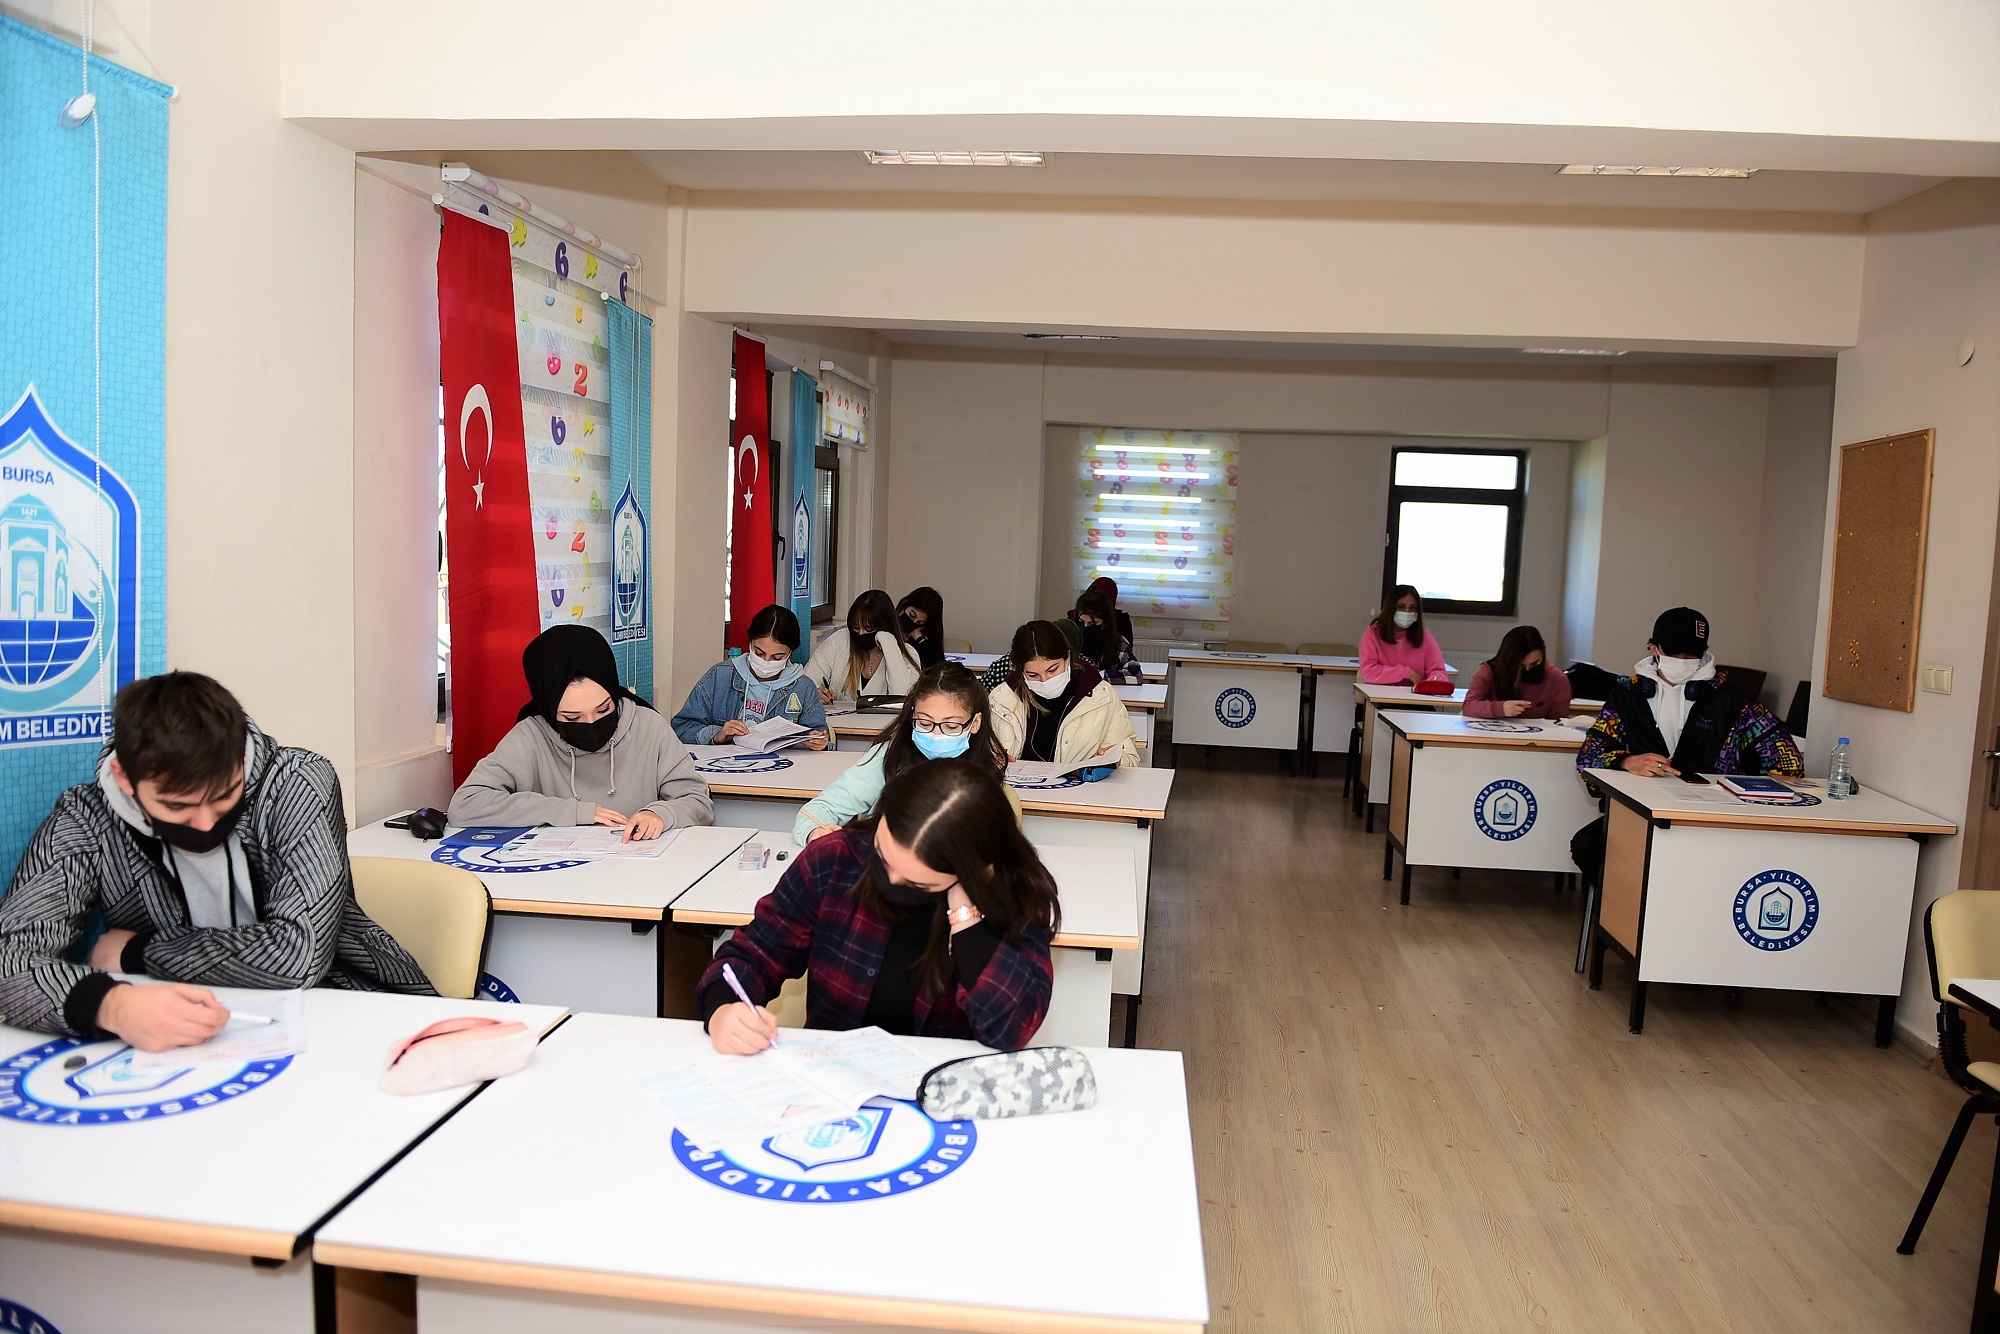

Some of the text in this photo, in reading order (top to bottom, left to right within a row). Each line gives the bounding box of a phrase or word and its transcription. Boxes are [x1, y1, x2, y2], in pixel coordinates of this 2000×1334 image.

[3, 466, 55, 485] BURSA
[17, 714, 113, 739] BELEDİYE
[1475, 781, 1535, 813] BURSA YILDIRIM
[1735, 872, 1816, 913] BURSA YILDIRIM
[124, 1071, 270, 1121] BURSA
[865, 1134, 969, 1196] BURSA
